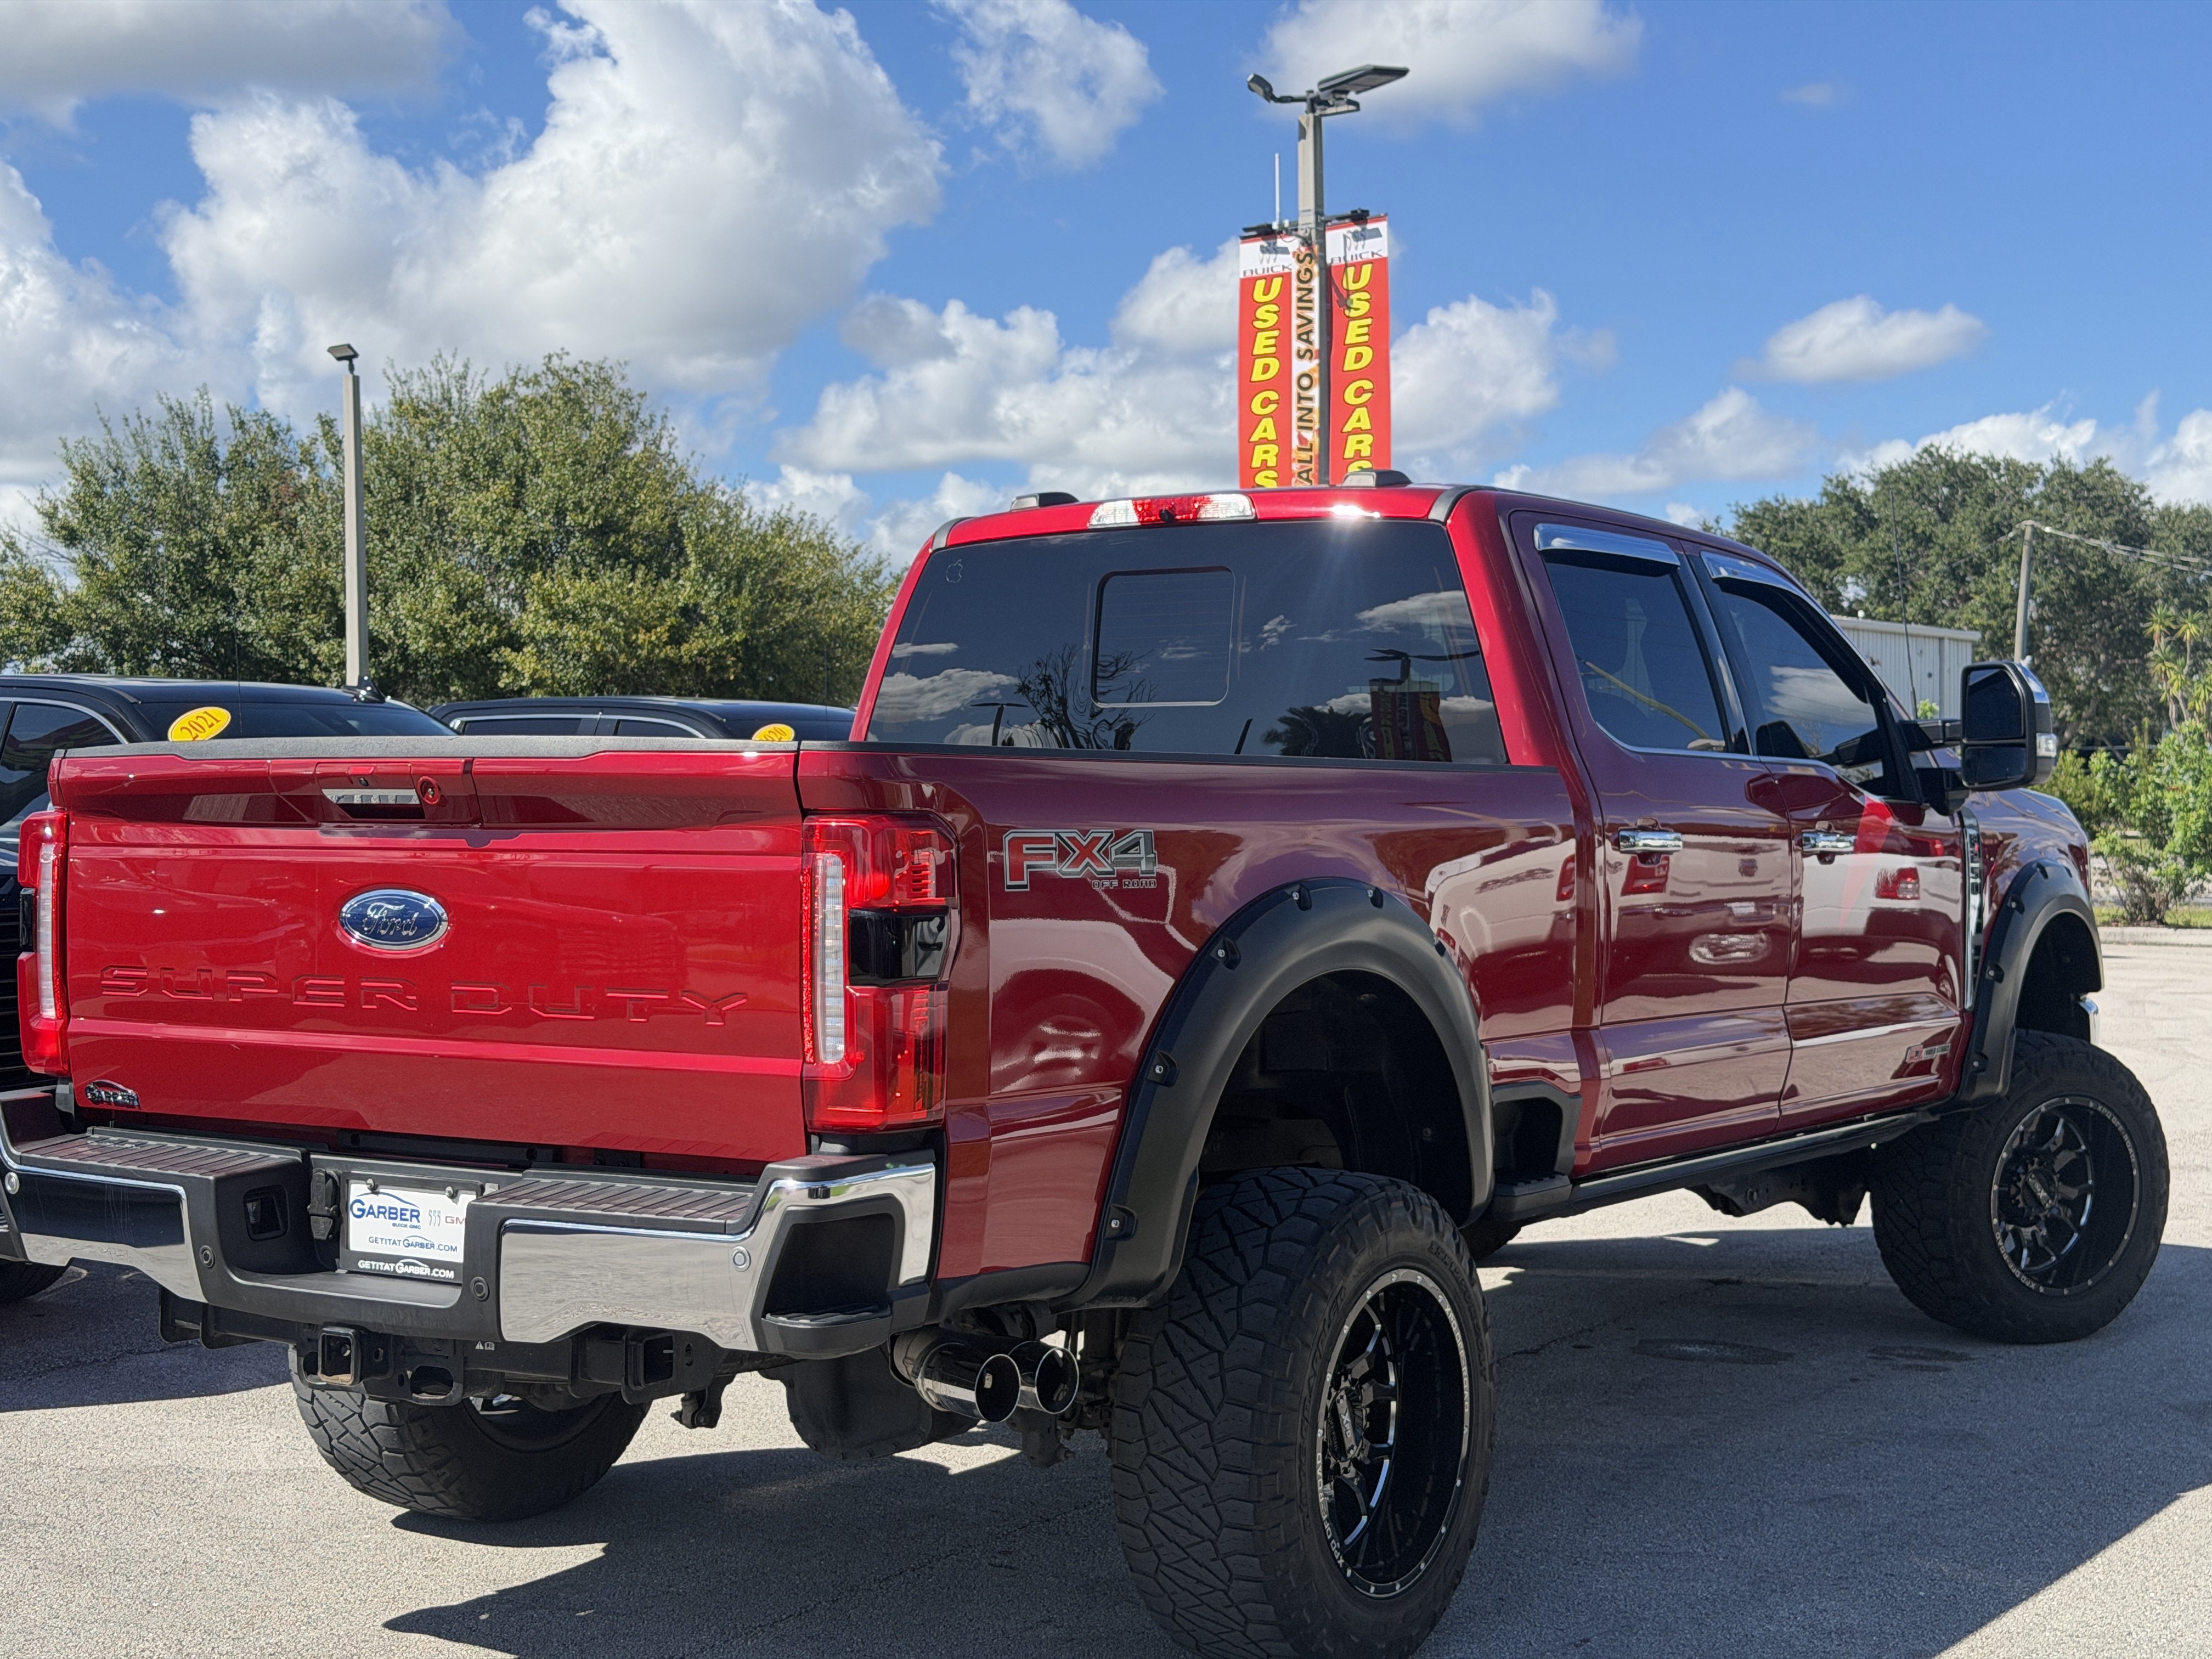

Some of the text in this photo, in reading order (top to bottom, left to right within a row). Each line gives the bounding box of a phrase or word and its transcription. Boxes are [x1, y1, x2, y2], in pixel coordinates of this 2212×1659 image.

[1341, 262, 1374, 373] USED
[1248, 276, 1284, 488] USED CARS
[1296, 252, 1314, 486] ALL INTO SAVINGS
[180, 711, 221, 741] 2021
[763, 726, 787, 741] 020
[1003, 829, 1158, 891] FX4
[1091, 879, 1157, 889] OFF ROAD
[362, 902, 420, 936] Ford
[100, 965, 748, 1026] SUPER DUTY
[85, 1083, 140, 1109] GARBER
[350, 1199, 421, 1223] GARBER
[445, 1216, 466, 1225] GM
[1340, 1407, 1352, 1438] XPD
[1329, 1537, 1345, 1569] XPD
